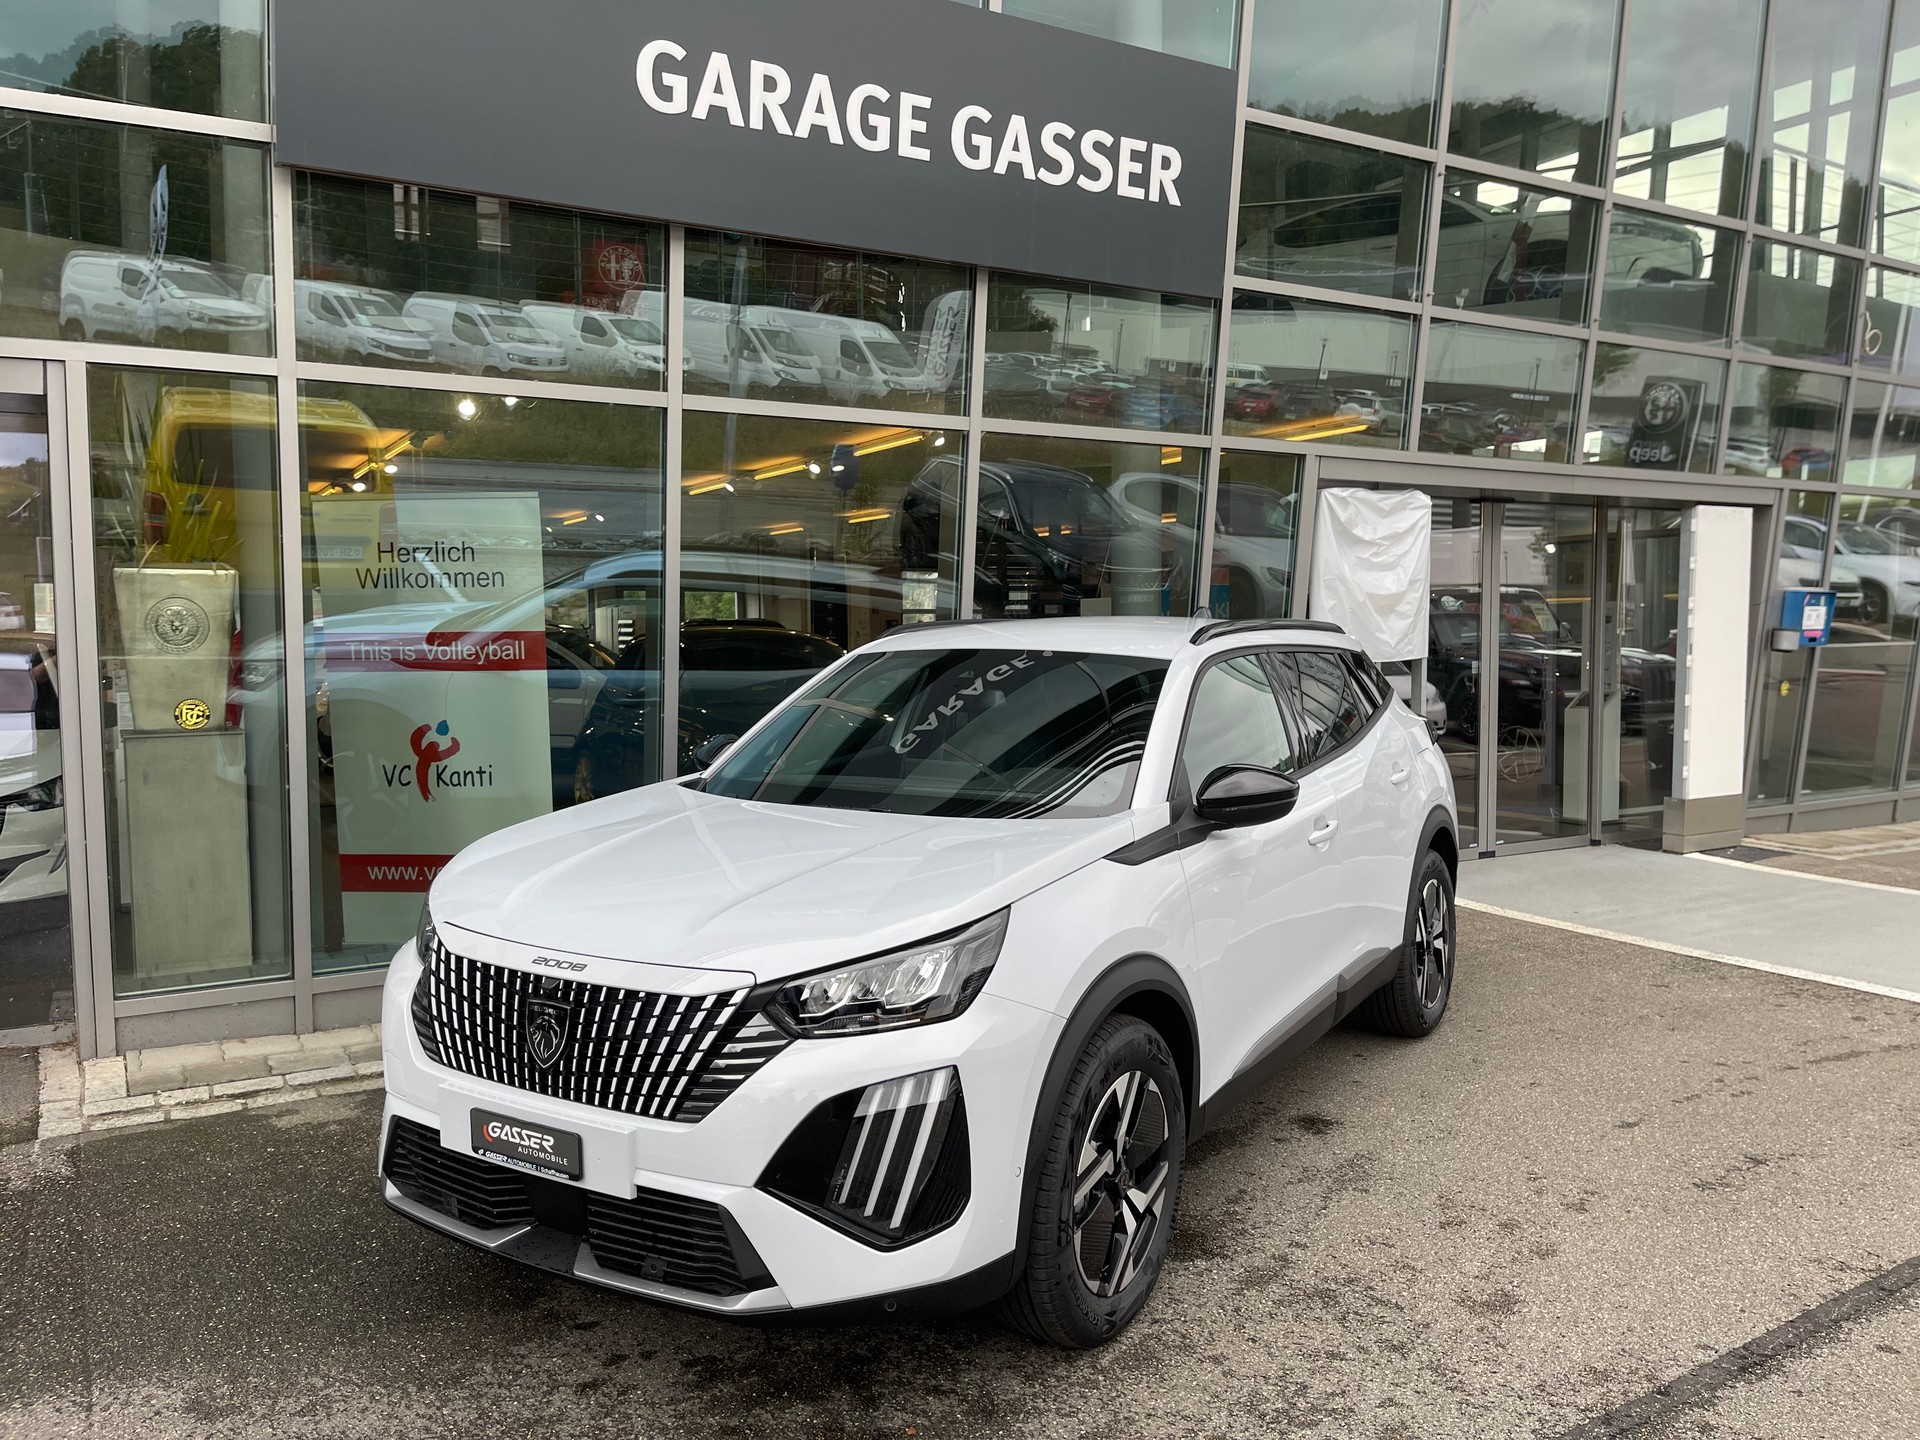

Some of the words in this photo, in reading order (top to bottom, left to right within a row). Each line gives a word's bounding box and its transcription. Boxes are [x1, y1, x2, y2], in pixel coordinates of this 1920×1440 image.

[636, 39, 933, 161] GARAGE
[950, 104, 1183, 207] GASSER
[377, 541, 475, 563] Herzlich
[356, 567, 505, 589] Willkommen
[345, 641, 392, 661] This
[399, 641, 416, 660] is
[423, 640, 526, 664] Volleyball
[382, 764, 412, 788] VC
[436, 764, 493, 788] Kanti
[531, 956, 588, 972] 2008
[488, 1121, 555, 1153] GASSER
[485, 1151, 508, 1163] GASSER
[507, 1159, 537, 1171] AUTOMOBILE
[517, 1146, 569, 1166] AUTOMOBILE
